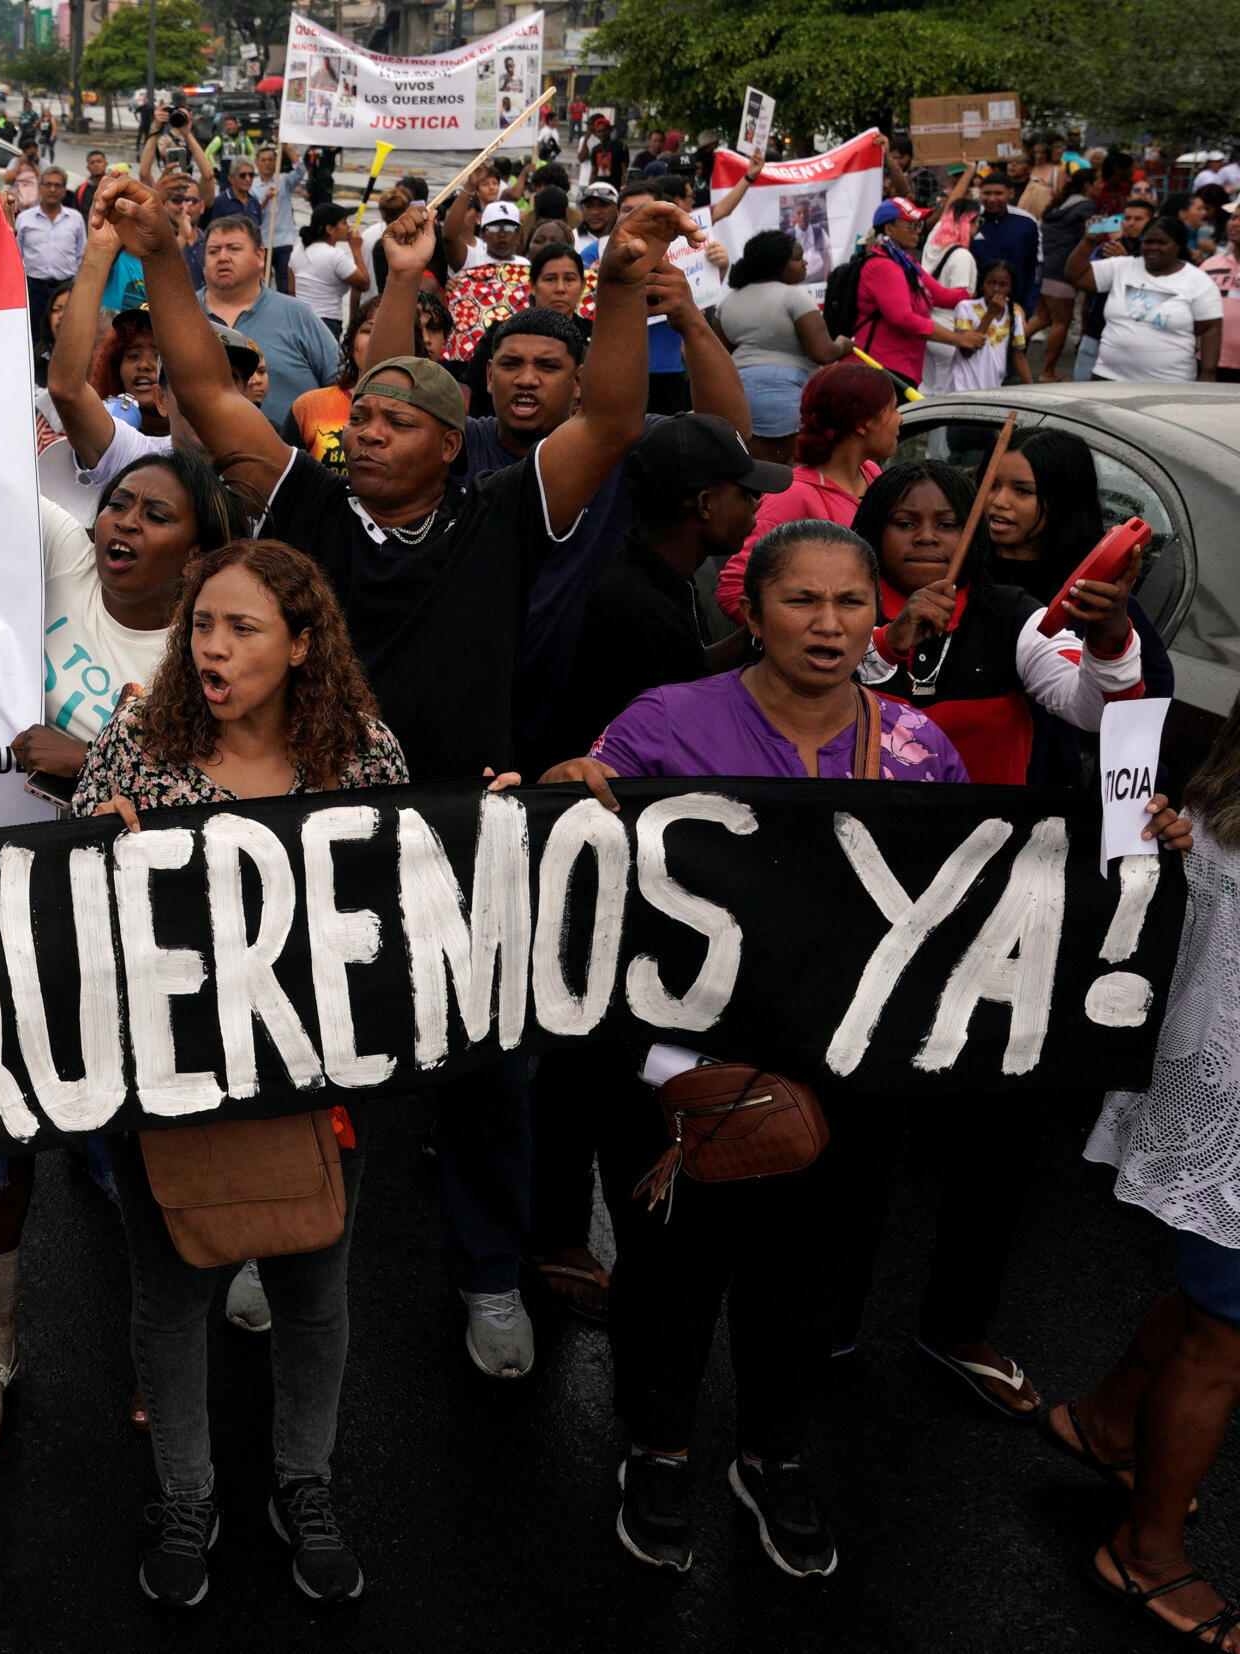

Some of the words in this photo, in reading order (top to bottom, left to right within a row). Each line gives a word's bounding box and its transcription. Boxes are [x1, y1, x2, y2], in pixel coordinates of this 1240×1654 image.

[395, 81, 435, 92] VIVOS
[364, 94, 388, 105] LOS
[392, 94, 465, 106] QUEREMOS
[369, 115, 459, 130] JUSTICIA
[825, 812, 1160, 1078] YA!
